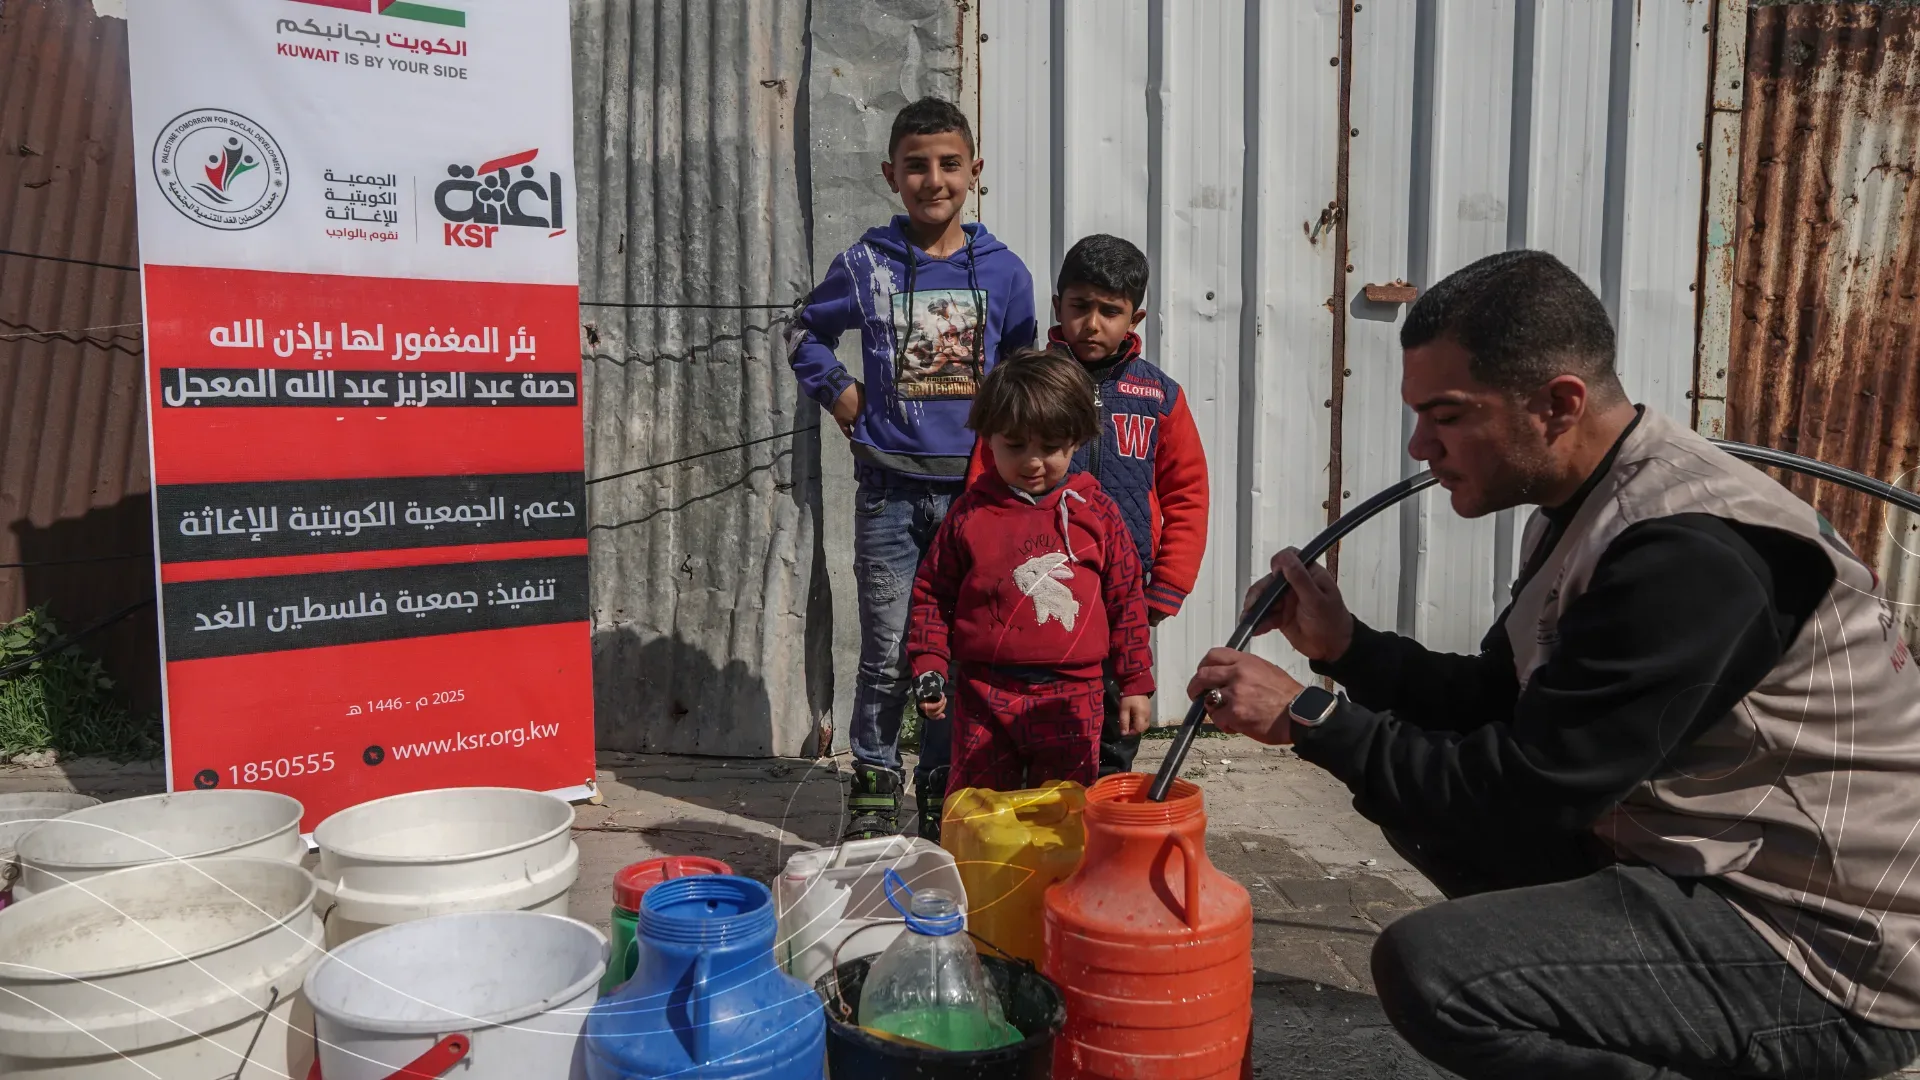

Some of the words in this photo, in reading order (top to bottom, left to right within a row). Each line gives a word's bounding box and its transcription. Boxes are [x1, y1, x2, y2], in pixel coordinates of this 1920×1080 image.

[276, 18, 380, 48] بجانبكم
[386, 32, 467, 57] الكويت
[277, 42, 339, 63] KUWAIT
[344, 52, 359, 66] IS
[364, 55, 384, 69] BY
[388, 58, 429, 75] YOUR
[433, 64, 468, 80] SIDE
[161, 133, 178, 164] PALESTINE
[175, 116, 213, 135] TOMORROW
[213, 116, 228, 124] FOR
[254, 133, 282, 175] DEVELOPMENT
[193, 207, 222, 223] للتنمية
[262, 192, 279, 211] جمعية
[223, 216, 238, 224] الغد
[238, 208, 263, 225] فلسطين
[326, 227, 367, 241] بالواجب
[369, 230, 398, 242] نقوم
[209, 318, 265, 348] الله
[273, 322, 333, 360] بإذن
[340, 322, 384, 351] لها
[391, 326, 499, 361] المغفور
[505, 326, 536, 362] بئر
[164, 367, 277, 407] المعجل
[285, 369, 336, 398] الله
[343, 378, 388, 406] عبد
[394, 371, 466, 407] العزيز
[473, 378, 515, 406] عبد
[520, 373, 575, 398] حصة
[1111, 413, 1156, 460] W
[179, 505, 279, 542] للإغاثة
[288, 501, 396, 537] الكويتية
[404, 496, 505, 530] الجمعية
[514, 500, 576, 527] دعم:
[1018, 533, 1060, 556] LOVELY
[396, 589, 479, 618] جمعية
[487, 578, 556, 610] تنفيذ:
[194, 600, 256, 632] الغد
[266, 592, 388, 633] فلسطين
[367, 697, 403, 713] 1446
[415, 696, 429, 711] م
[432, 689, 465, 705] 2025
[392, 720, 560, 761] www.ksr.org.kw
[229, 751, 335, 785] 1850555
